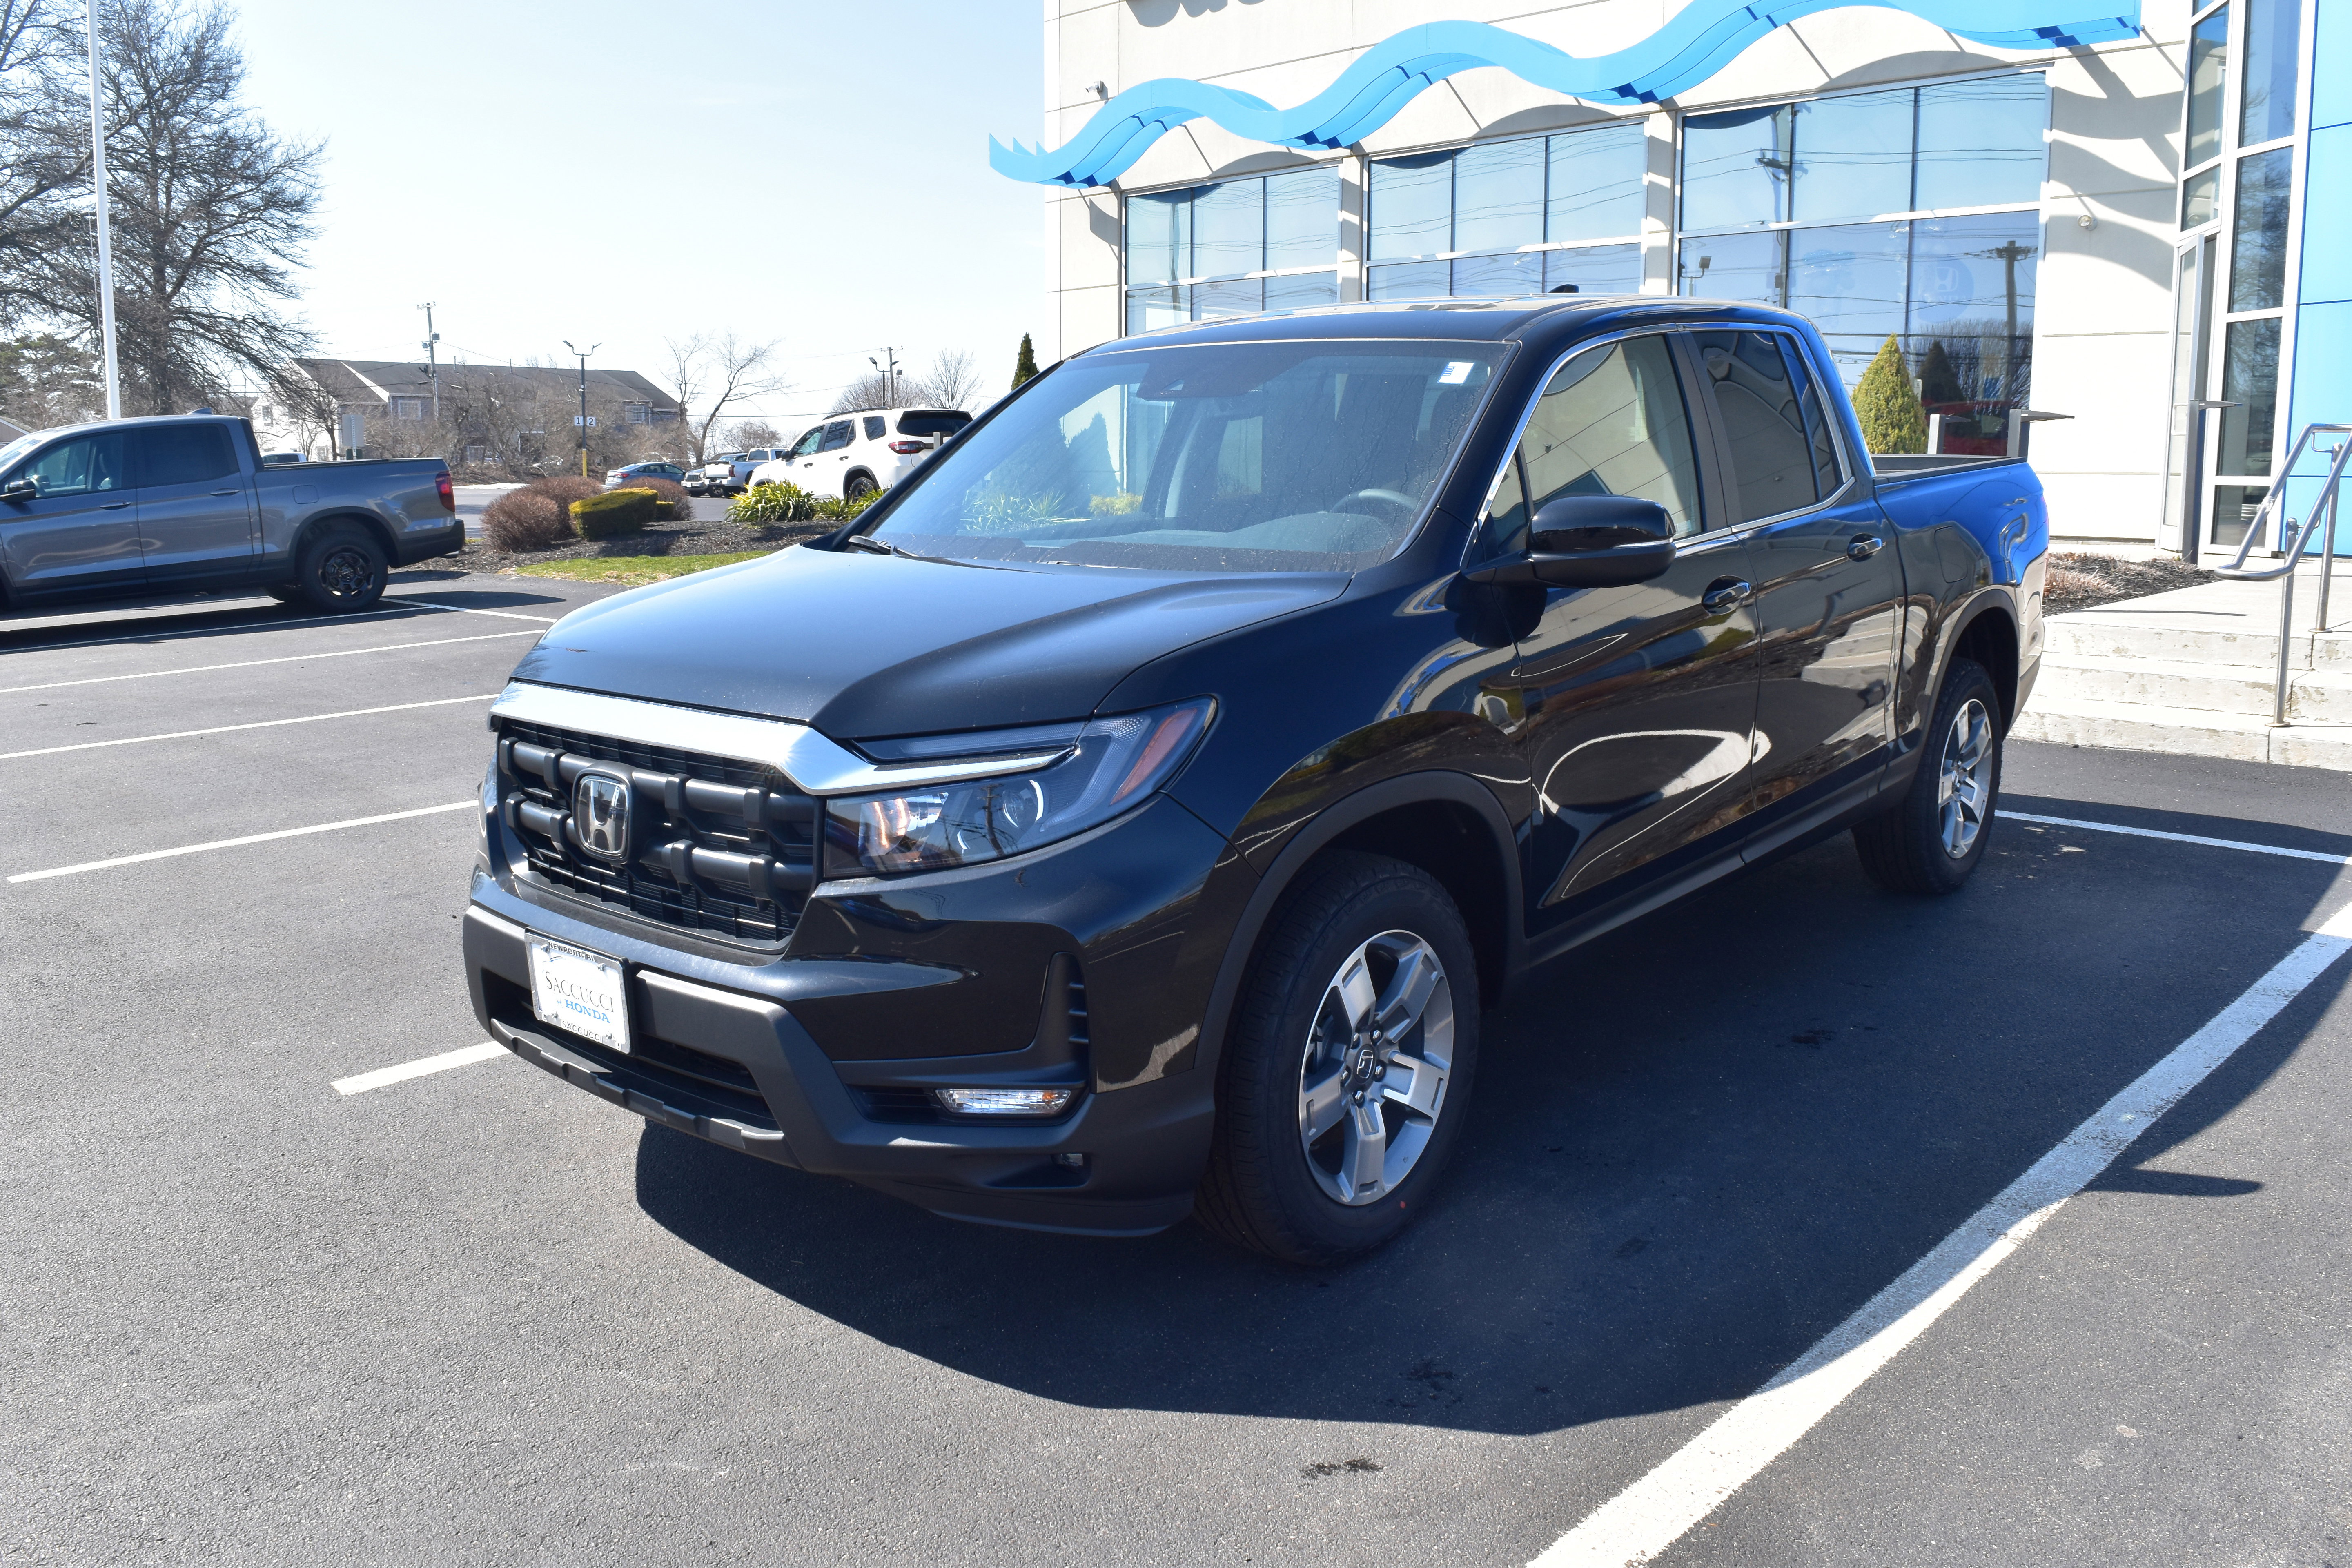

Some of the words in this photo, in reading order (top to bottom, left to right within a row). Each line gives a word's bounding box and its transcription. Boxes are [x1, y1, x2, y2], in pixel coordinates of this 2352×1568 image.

[545, 971, 614, 1013] SACCUCCI
[564, 999, 611, 1023] HONDA
[562, 1020, 602, 1042] SACCUCCI
